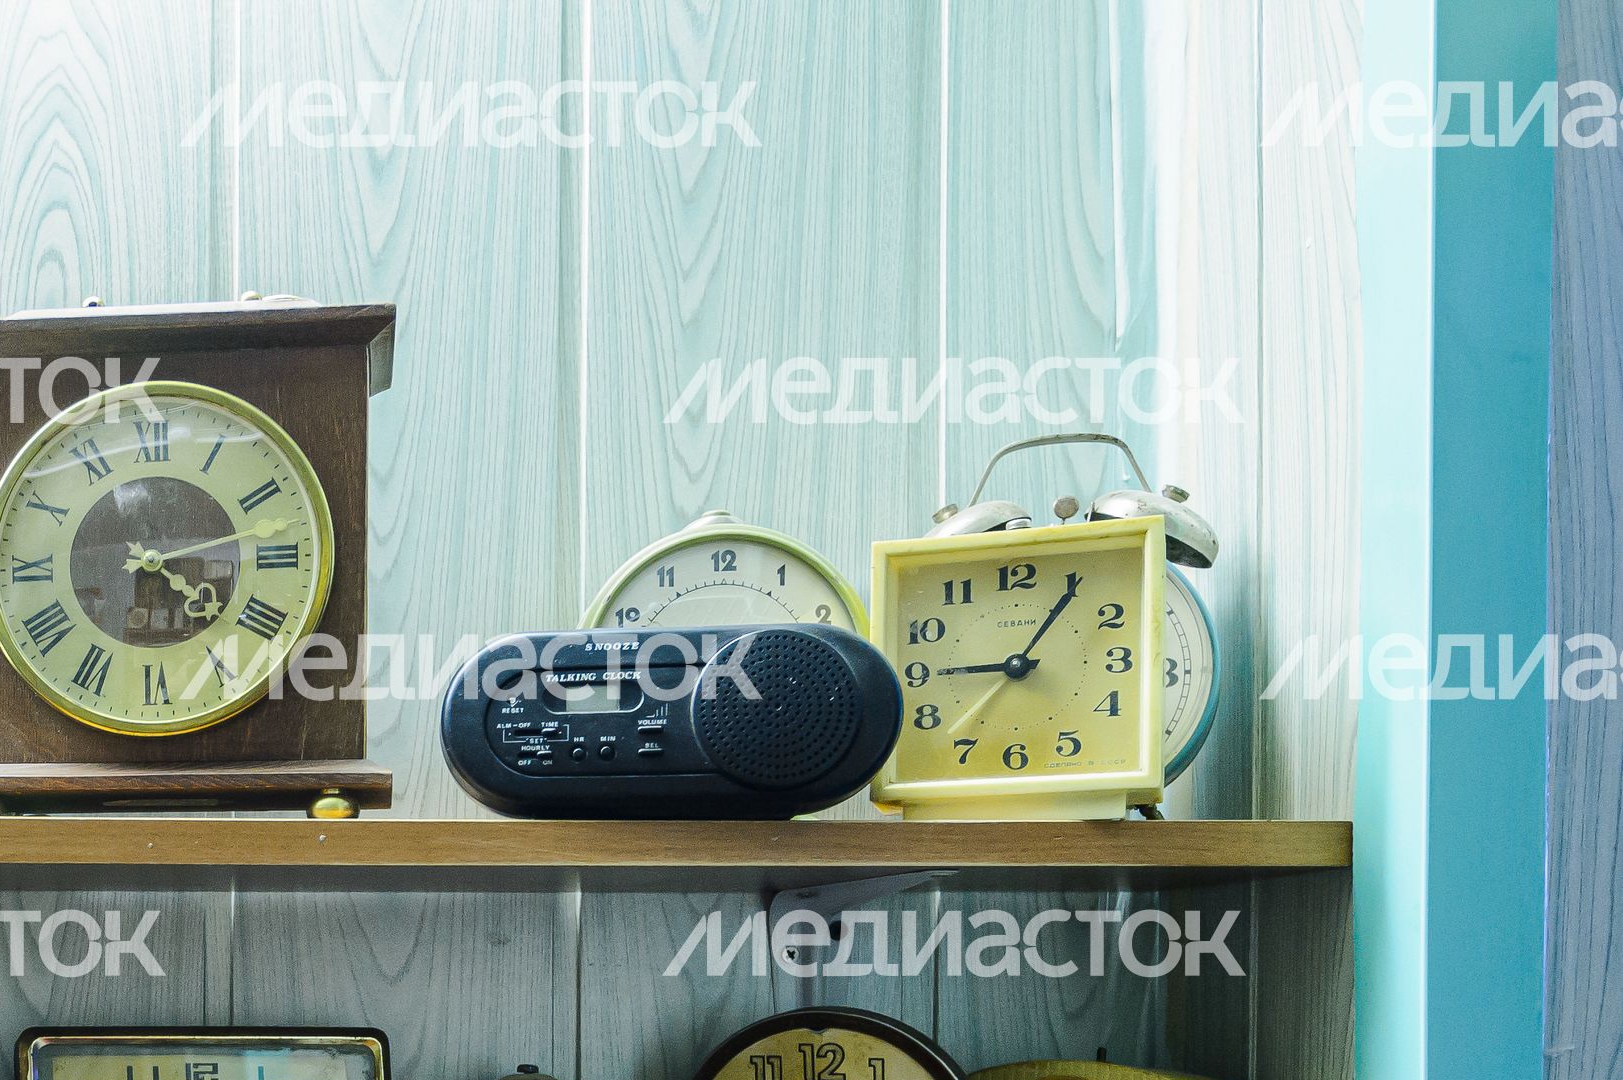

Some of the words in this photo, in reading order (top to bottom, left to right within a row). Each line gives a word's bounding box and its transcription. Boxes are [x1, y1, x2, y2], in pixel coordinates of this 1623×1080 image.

[133, 420, 171, 463] XII
[70, 437, 114, 486] XI
[26, 490, 70, 526] X
[238, 477, 282, 515] II
[12, 553, 53, 584] IX
[256, 542, 299, 571] III
[711, 549, 738, 572] 12
[656, 564, 676, 588] 11
[777, 564, 787, 586] 1
[996, 563, 1037, 591] 12
[942, 578, 974, 606] 11
[996, 619, 1037, 629] СЕВАНИ
[1097, 603, 1126, 631] 2
[907, 617, 946, 645] 10
[585, 642, 640, 651] SNOOZE
[1105, 647, 1133, 673] 3
[71, 643, 114, 698] VII
[142, 661, 173, 706] VI
[546, 673, 596, 682] TALKING
[603, 672, 641, 680] CLOCK
[913, 704, 941, 730] 8
[1093, 690, 1122, 717] 4
[953, 738, 979, 765] 7
[1002, 743, 1029, 770] 6
[1055, 730, 1081, 757] 5
